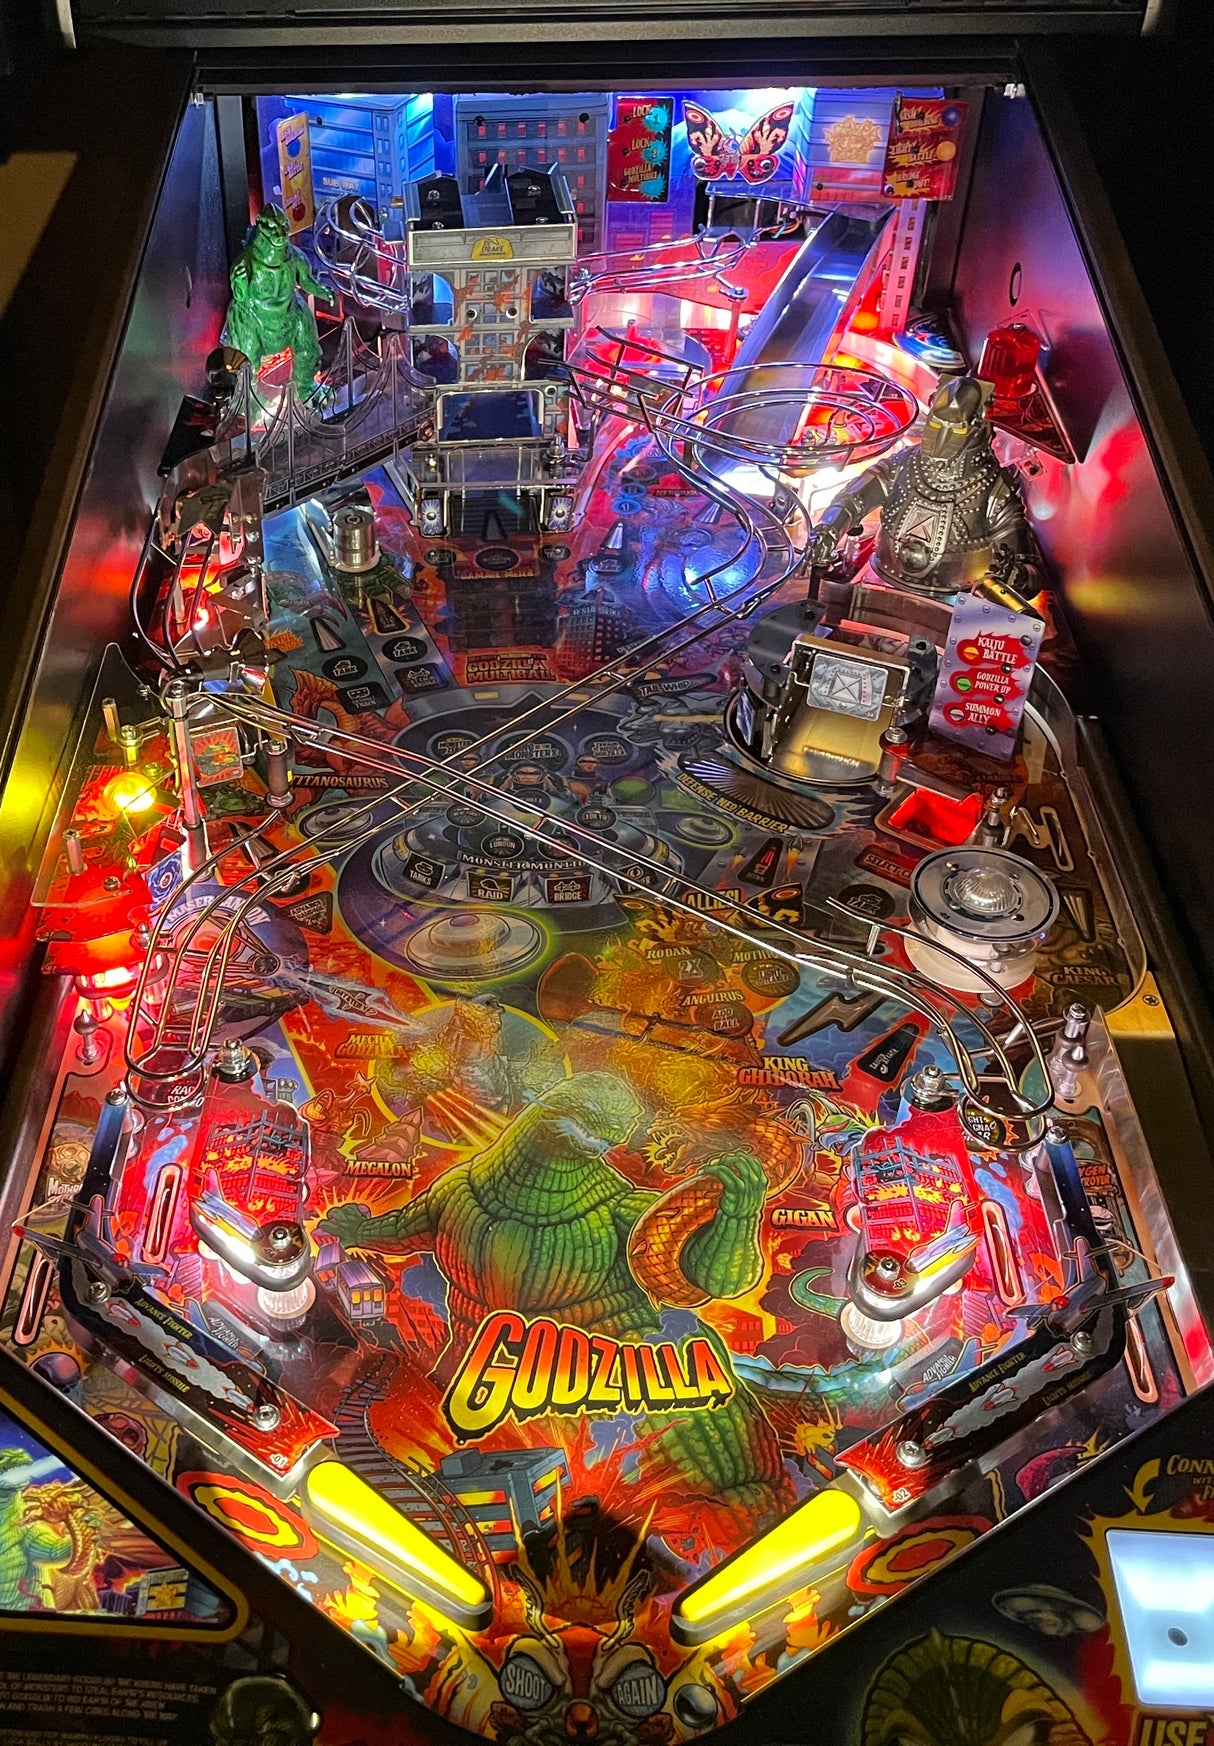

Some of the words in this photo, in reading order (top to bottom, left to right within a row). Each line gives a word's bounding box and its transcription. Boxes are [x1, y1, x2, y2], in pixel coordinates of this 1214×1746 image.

[633, 104, 652, 117] LOCK
[653, 114, 660, 124] 1
[631, 138, 651, 150] LOCK
[652, 149, 658, 158] 2
[623, 164, 653, 176] GODZILLA
[978, 637, 1005, 650] KAIJU
[392, 645, 418, 657] TANK
[982, 649, 1018, 664] BATTLE
[333, 665, 358, 677] TANK
[467, 659, 546, 673] GODZILLA
[467, 670, 557, 683] MULTIBALL
[976, 672, 1009, 685] GODZILLA
[640, 684, 664, 697] TAIL
[663, 681, 690, 692] WHIP
[974, 681, 999, 693] POWER
[1000, 686, 1011, 694] UP
[965, 702, 1001, 717] SUMMON
[968, 713, 991, 724] ALLY
[291, 775, 389, 789] TITANOSAURUS
[676, 772, 717, 802] DEFENSE
[737, 805, 791, 833] BARRIER
[489, 841, 516, 849] LONDON
[863, 853, 899, 874] SELECT
[409, 870, 432, 886] TANKS
[477, 889, 504, 900] RAID
[554, 891, 581, 901] BRIDGE
[646, 946, 691, 959] RODAN
[1052, 974, 1117, 986] CAESAR
[682, 990, 744, 1006] ANGUIRUS
[712, 1008, 734, 1019] ADD
[714, 1019, 740, 1031] BALL
[763, 1057, 809, 1073] KING
[738, 1068, 841, 1091] GHIDORAH
[346, 1160, 412, 1178] MEGALON
[771, 1208, 836, 1229] GIGAN
[134, 1298, 167, 1321] ADVANCE
[163, 1316, 193, 1340] FIGHTER
[446, 1311, 734, 1433] GODZILLA
[922, 1354, 949, 1384] ADVANCE
[968, 1369, 999, 1393] ADVANCE
[997, 1352, 1026, 1374] FIGHTER
[162, 1371, 191, 1393] MISSILE
[269, 1453, 288, 1467] -01
[893, 1489, 911, 1502] -02
[72, 1685, 83, 1693] TO
[506, 1663, 547, 1701] SHOOT
[617, 1675, 659, 1705] AGAIN
[54, 1694, 65, 1702] TO
[1140, 1721, 1207, 1746] USE
